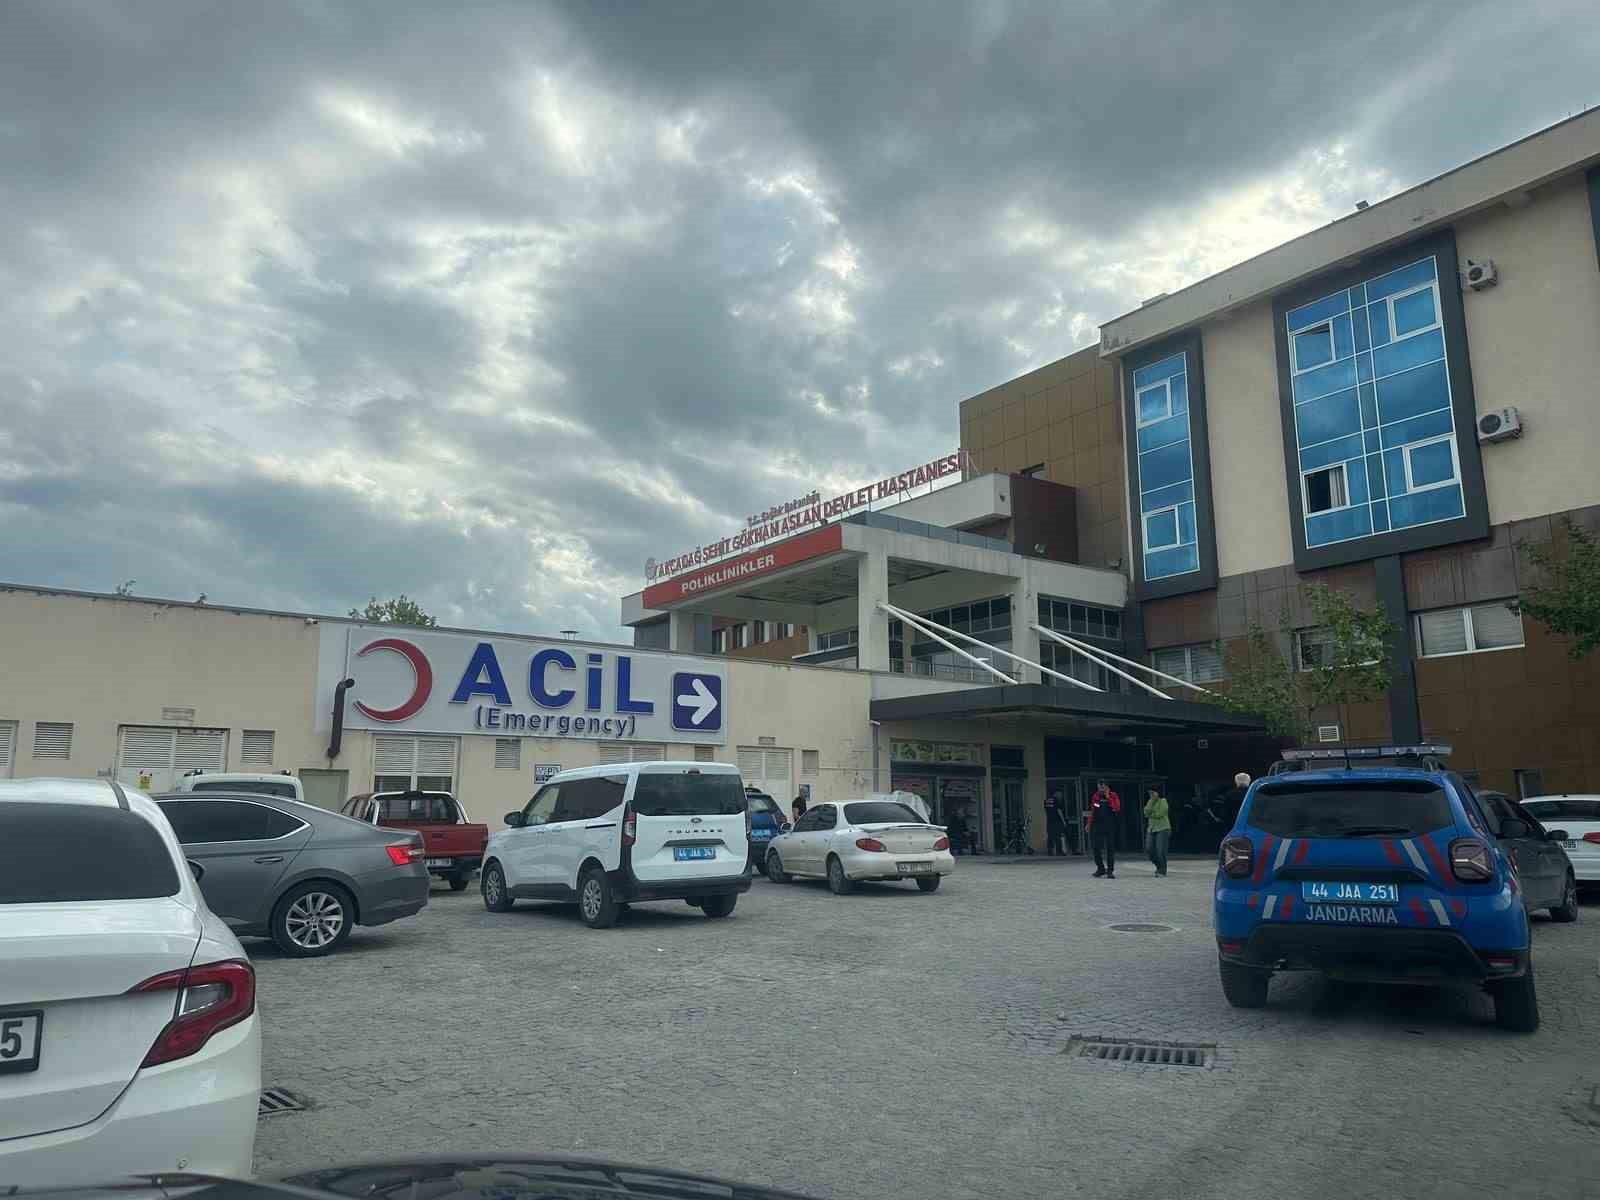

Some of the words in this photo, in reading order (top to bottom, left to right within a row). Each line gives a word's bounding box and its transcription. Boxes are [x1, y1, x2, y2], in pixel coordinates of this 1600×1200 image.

[703, 536, 732, 564] ŞEHİT
[733, 521, 780, 550] GÖKHAN
[781, 503, 820, 534] ASLAN
[823, 485, 875, 517] DEVLET
[877, 449, 963, 498] HASTANESİ
[681, 553, 775, 592] POLİKLİNİKLER
[475, 705, 636, 736] (Emergency)
[1311, 883, 1328, 897] 44
[1336, 883, 1361, 898] JAA
[1369, 884, 1394, 899] 251
[1305, 903, 1398, 924] JANDARMA
